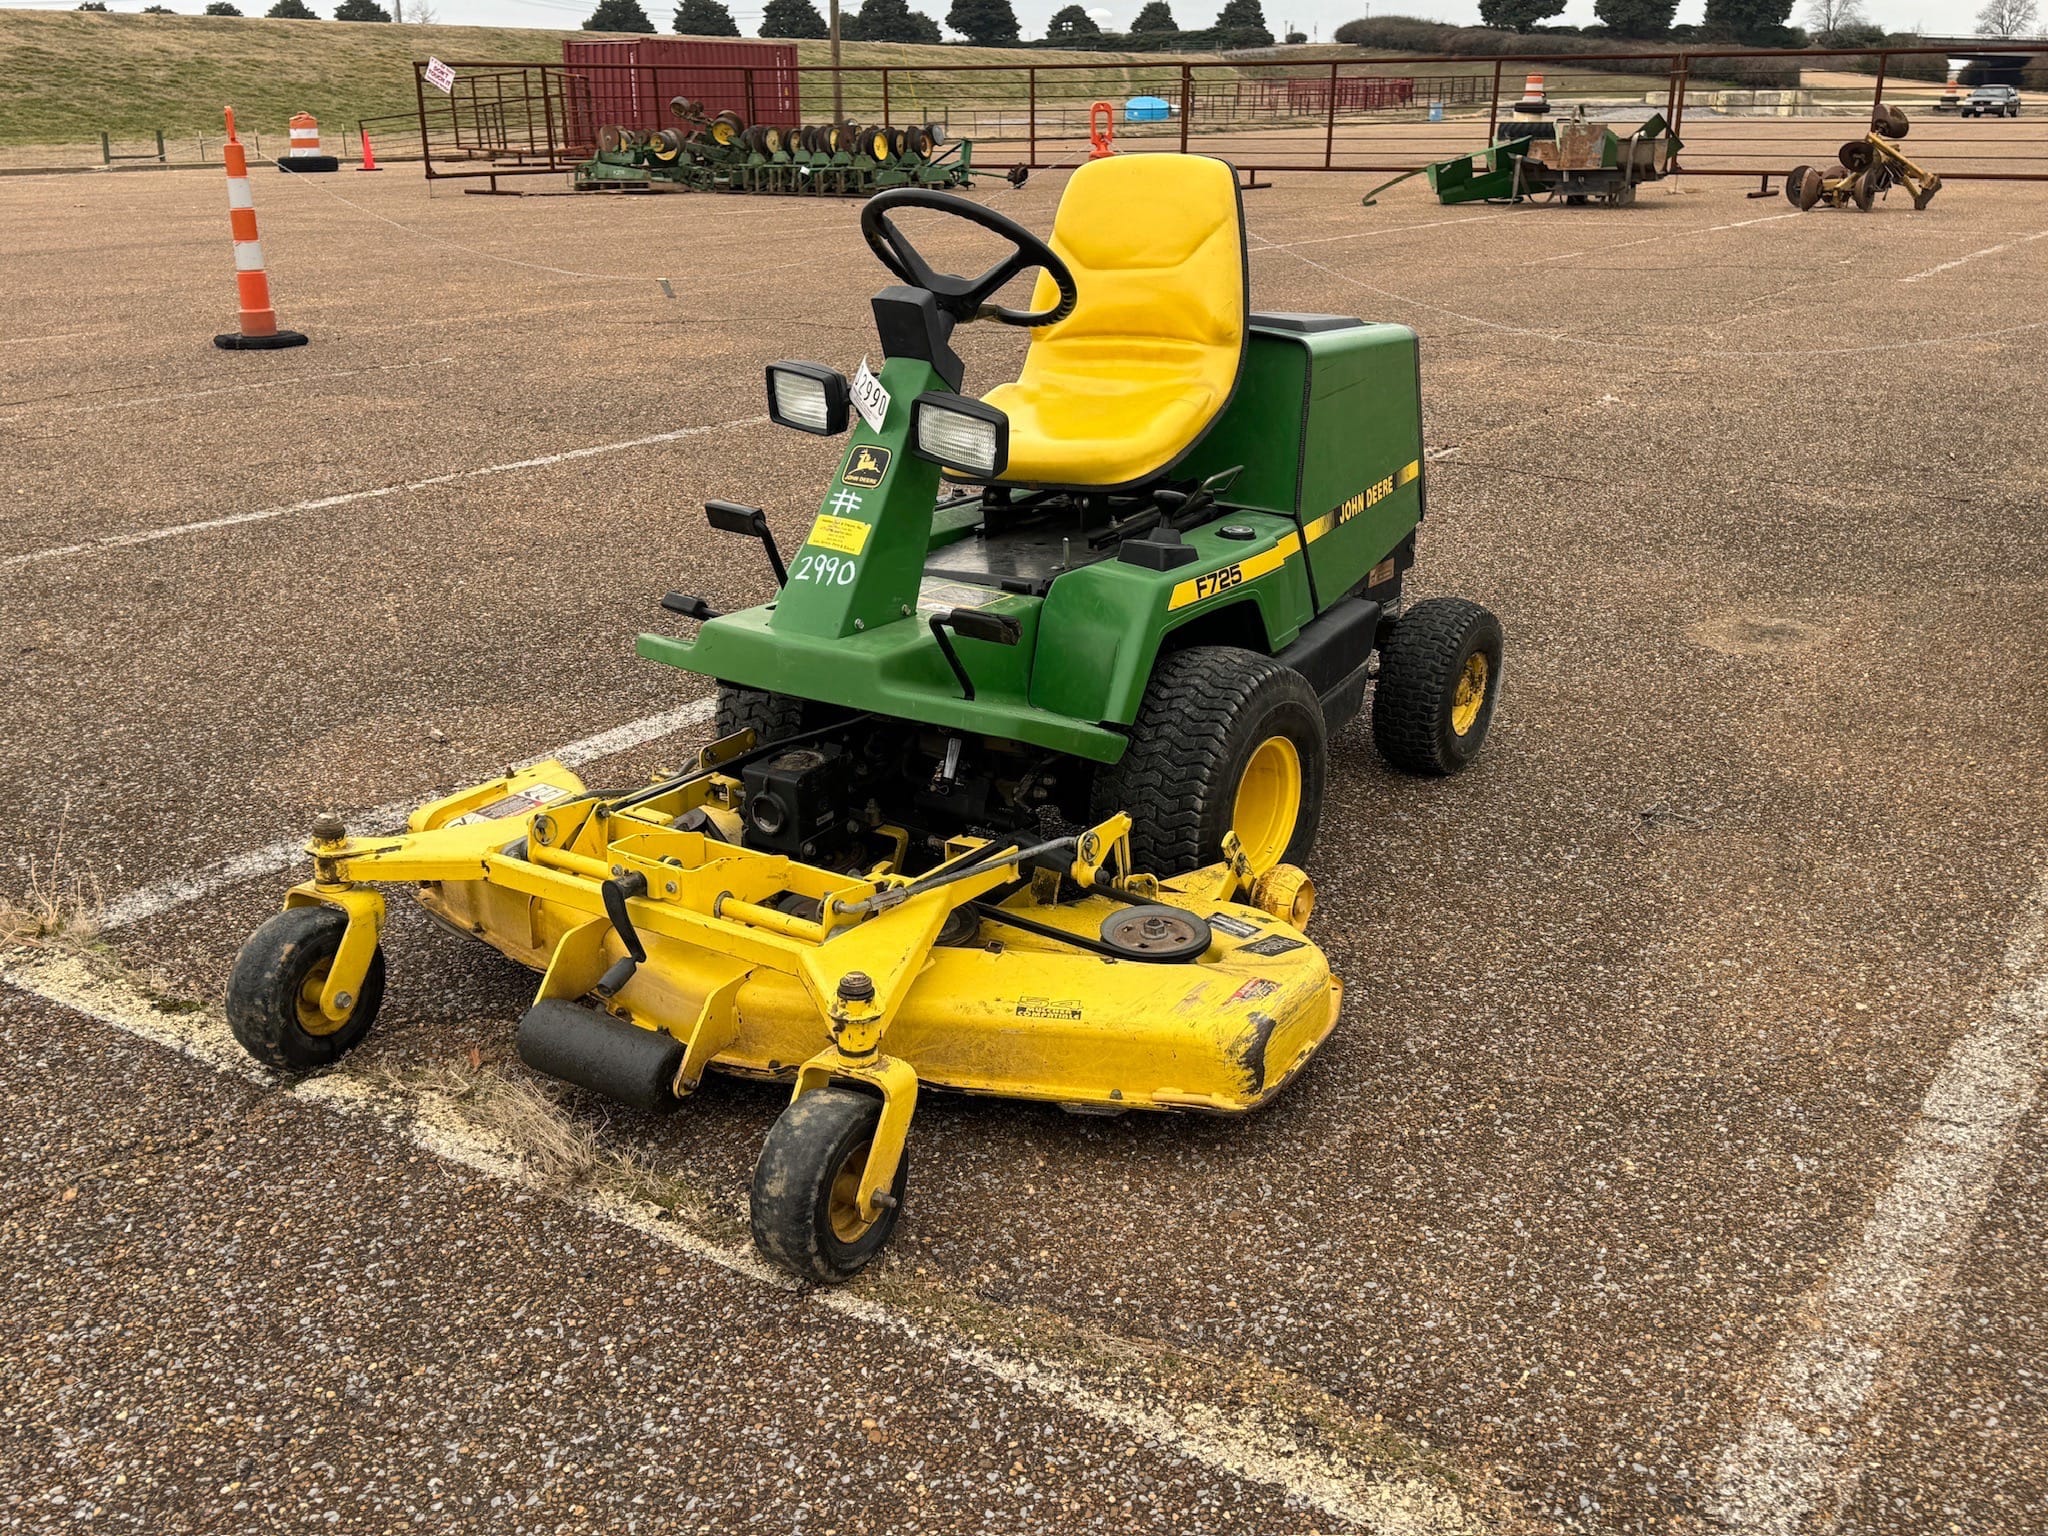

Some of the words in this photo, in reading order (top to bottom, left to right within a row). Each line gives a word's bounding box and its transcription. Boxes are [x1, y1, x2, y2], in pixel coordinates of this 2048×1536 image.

[845, 474, 859, 482] JOHN
[859, 476, 877, 484] DEERE
[1339, 492, 1365, 525] JOHN
[1366, 475, 1394, 509] DEERE
[795, 554, 856, 586] 2990
[1195, 565, 1243, 599] F725
